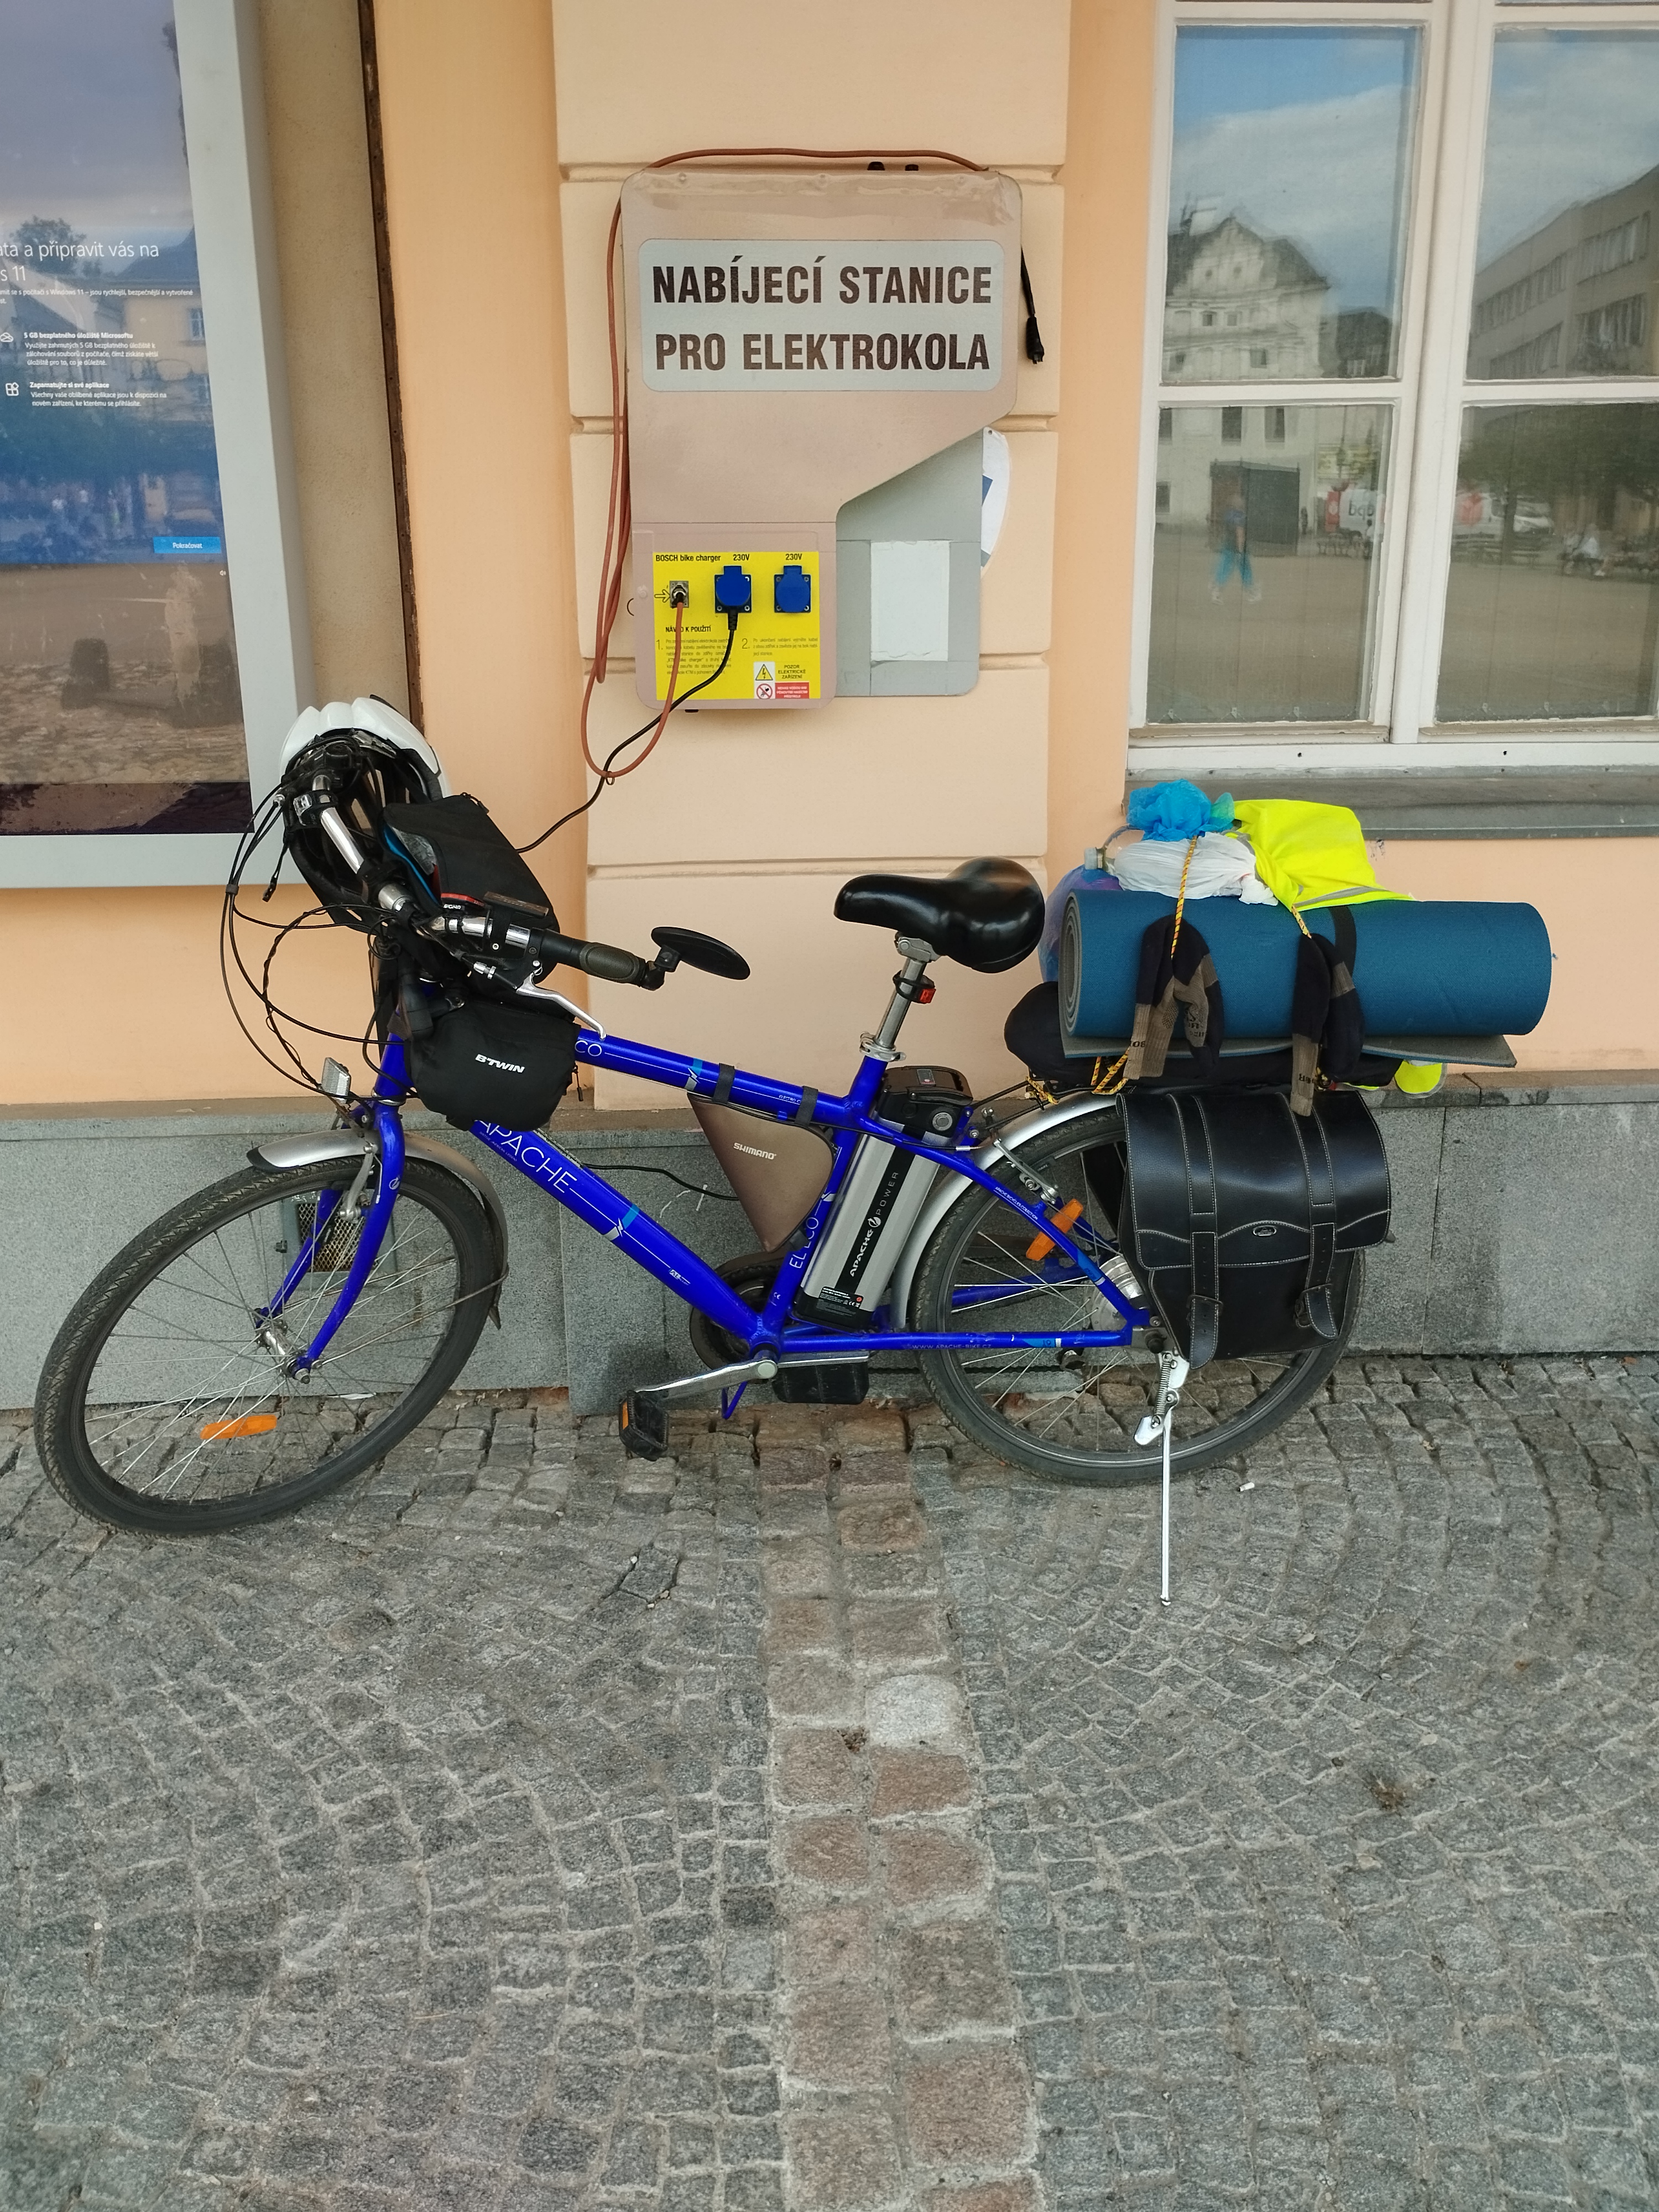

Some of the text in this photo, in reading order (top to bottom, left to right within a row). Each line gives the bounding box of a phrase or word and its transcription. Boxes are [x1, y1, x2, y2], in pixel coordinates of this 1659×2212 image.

[24, 244, 33, 257] a
[39, 240, 105, 262] připravit
[108, 241, 134, 257] vás
[140, 245, 159, 257] na
[12, 265, 25, 281] 11
[653, 255, 992, 304] NABÍJECÍ STANICE
[103, 289, 127, 297] rychlejší,
[128, 289, 160, 297] bezpečnější
[166, 289, 193, 297] vytvořené
[656, 333, 990, 371] PRO ELEKTROKOLA
[695, 555, 721, 563] charger
[656, 639, 663, 650] 1.
[742, 638, 750, 649] 2.
[574, 1040, 602, 1057] CO
[733, 1142, 775, 1160] SHIMANO
[875, 1172, 899, 1215] POWER
[850, 1229, 874, 1277] APACHE
